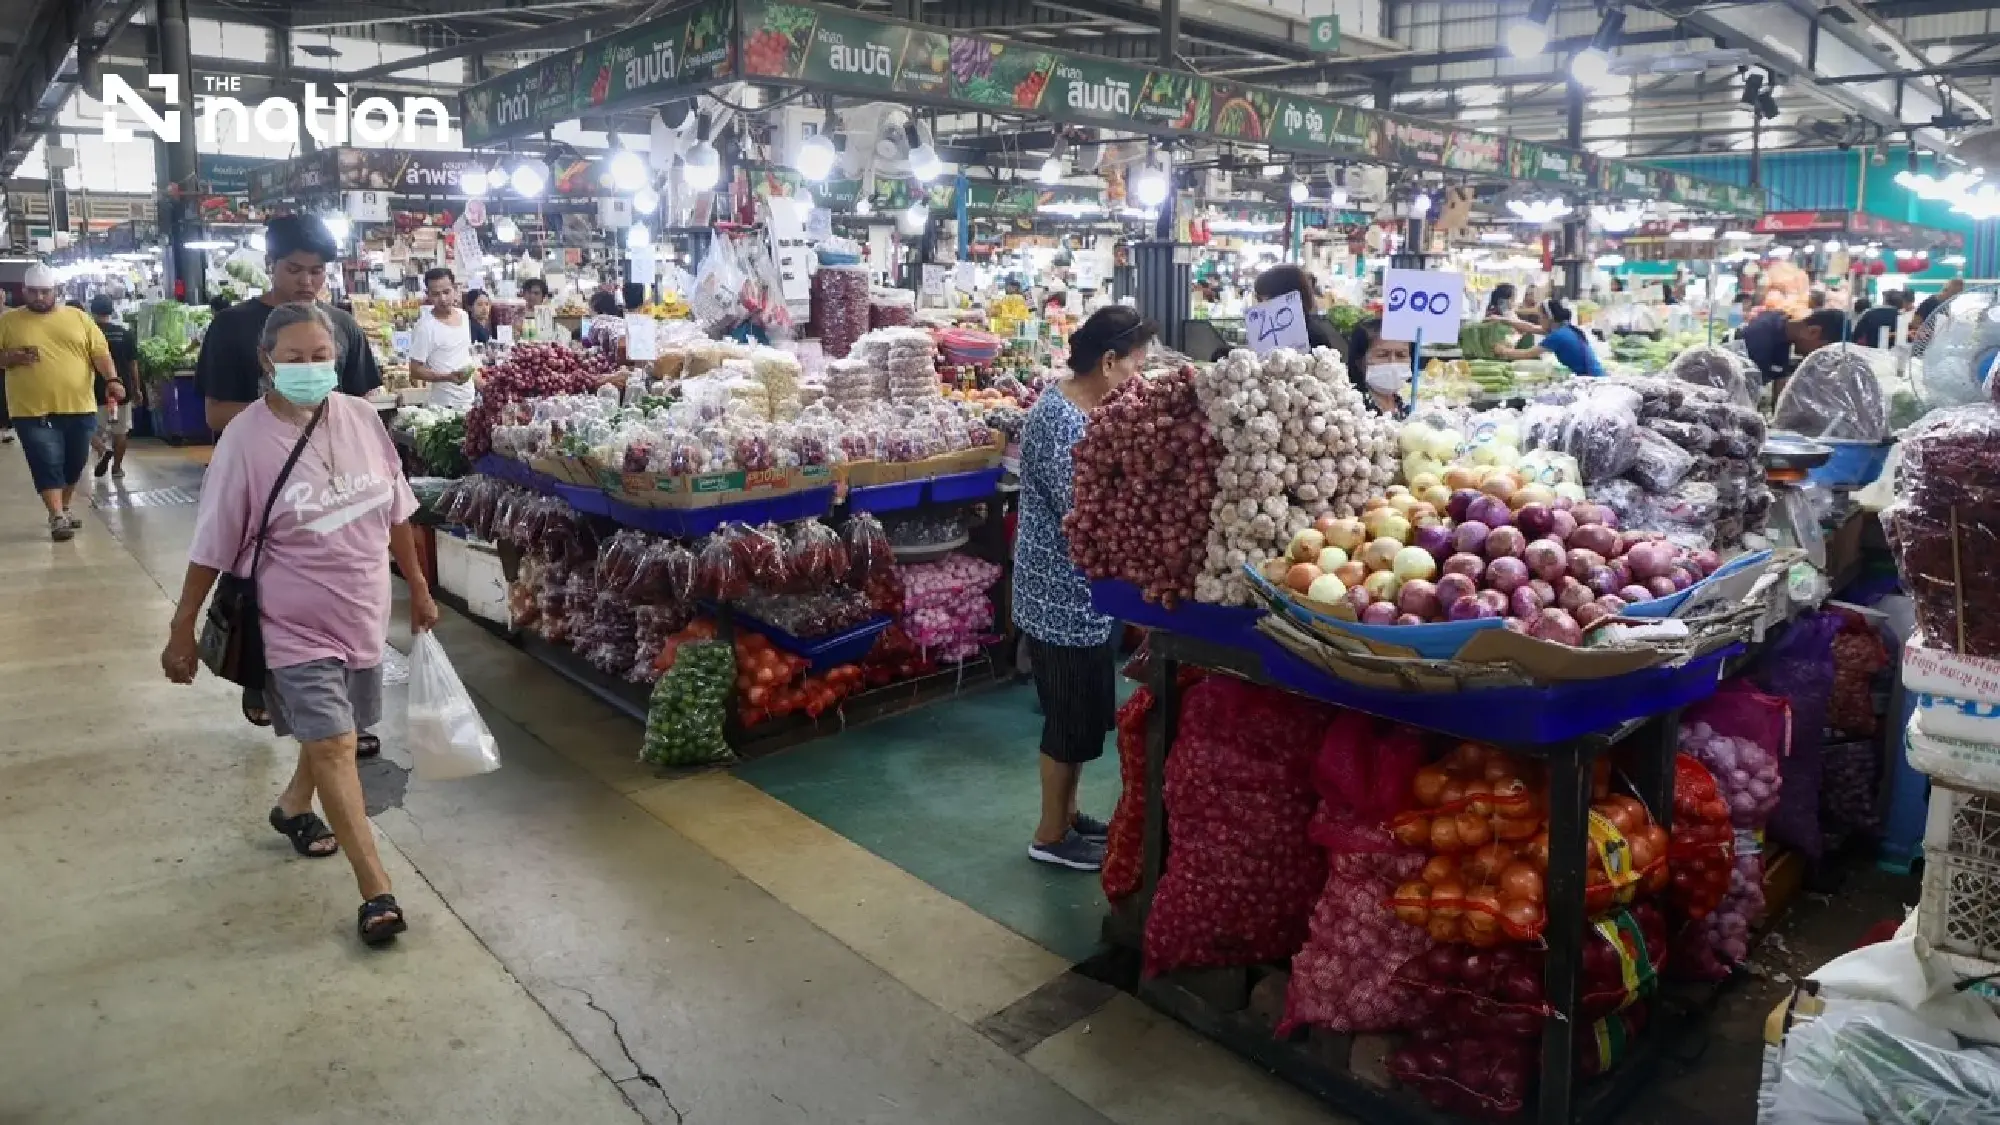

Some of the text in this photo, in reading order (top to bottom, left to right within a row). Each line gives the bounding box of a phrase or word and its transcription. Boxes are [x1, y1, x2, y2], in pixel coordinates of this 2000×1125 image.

[1317, 22, 1332, 43] 6
[625, 39, 675, 90] สมบัติ
[829, 41, 892, 78] สมบัติ
[1068, 76, 1131, 115] สมบัติ
